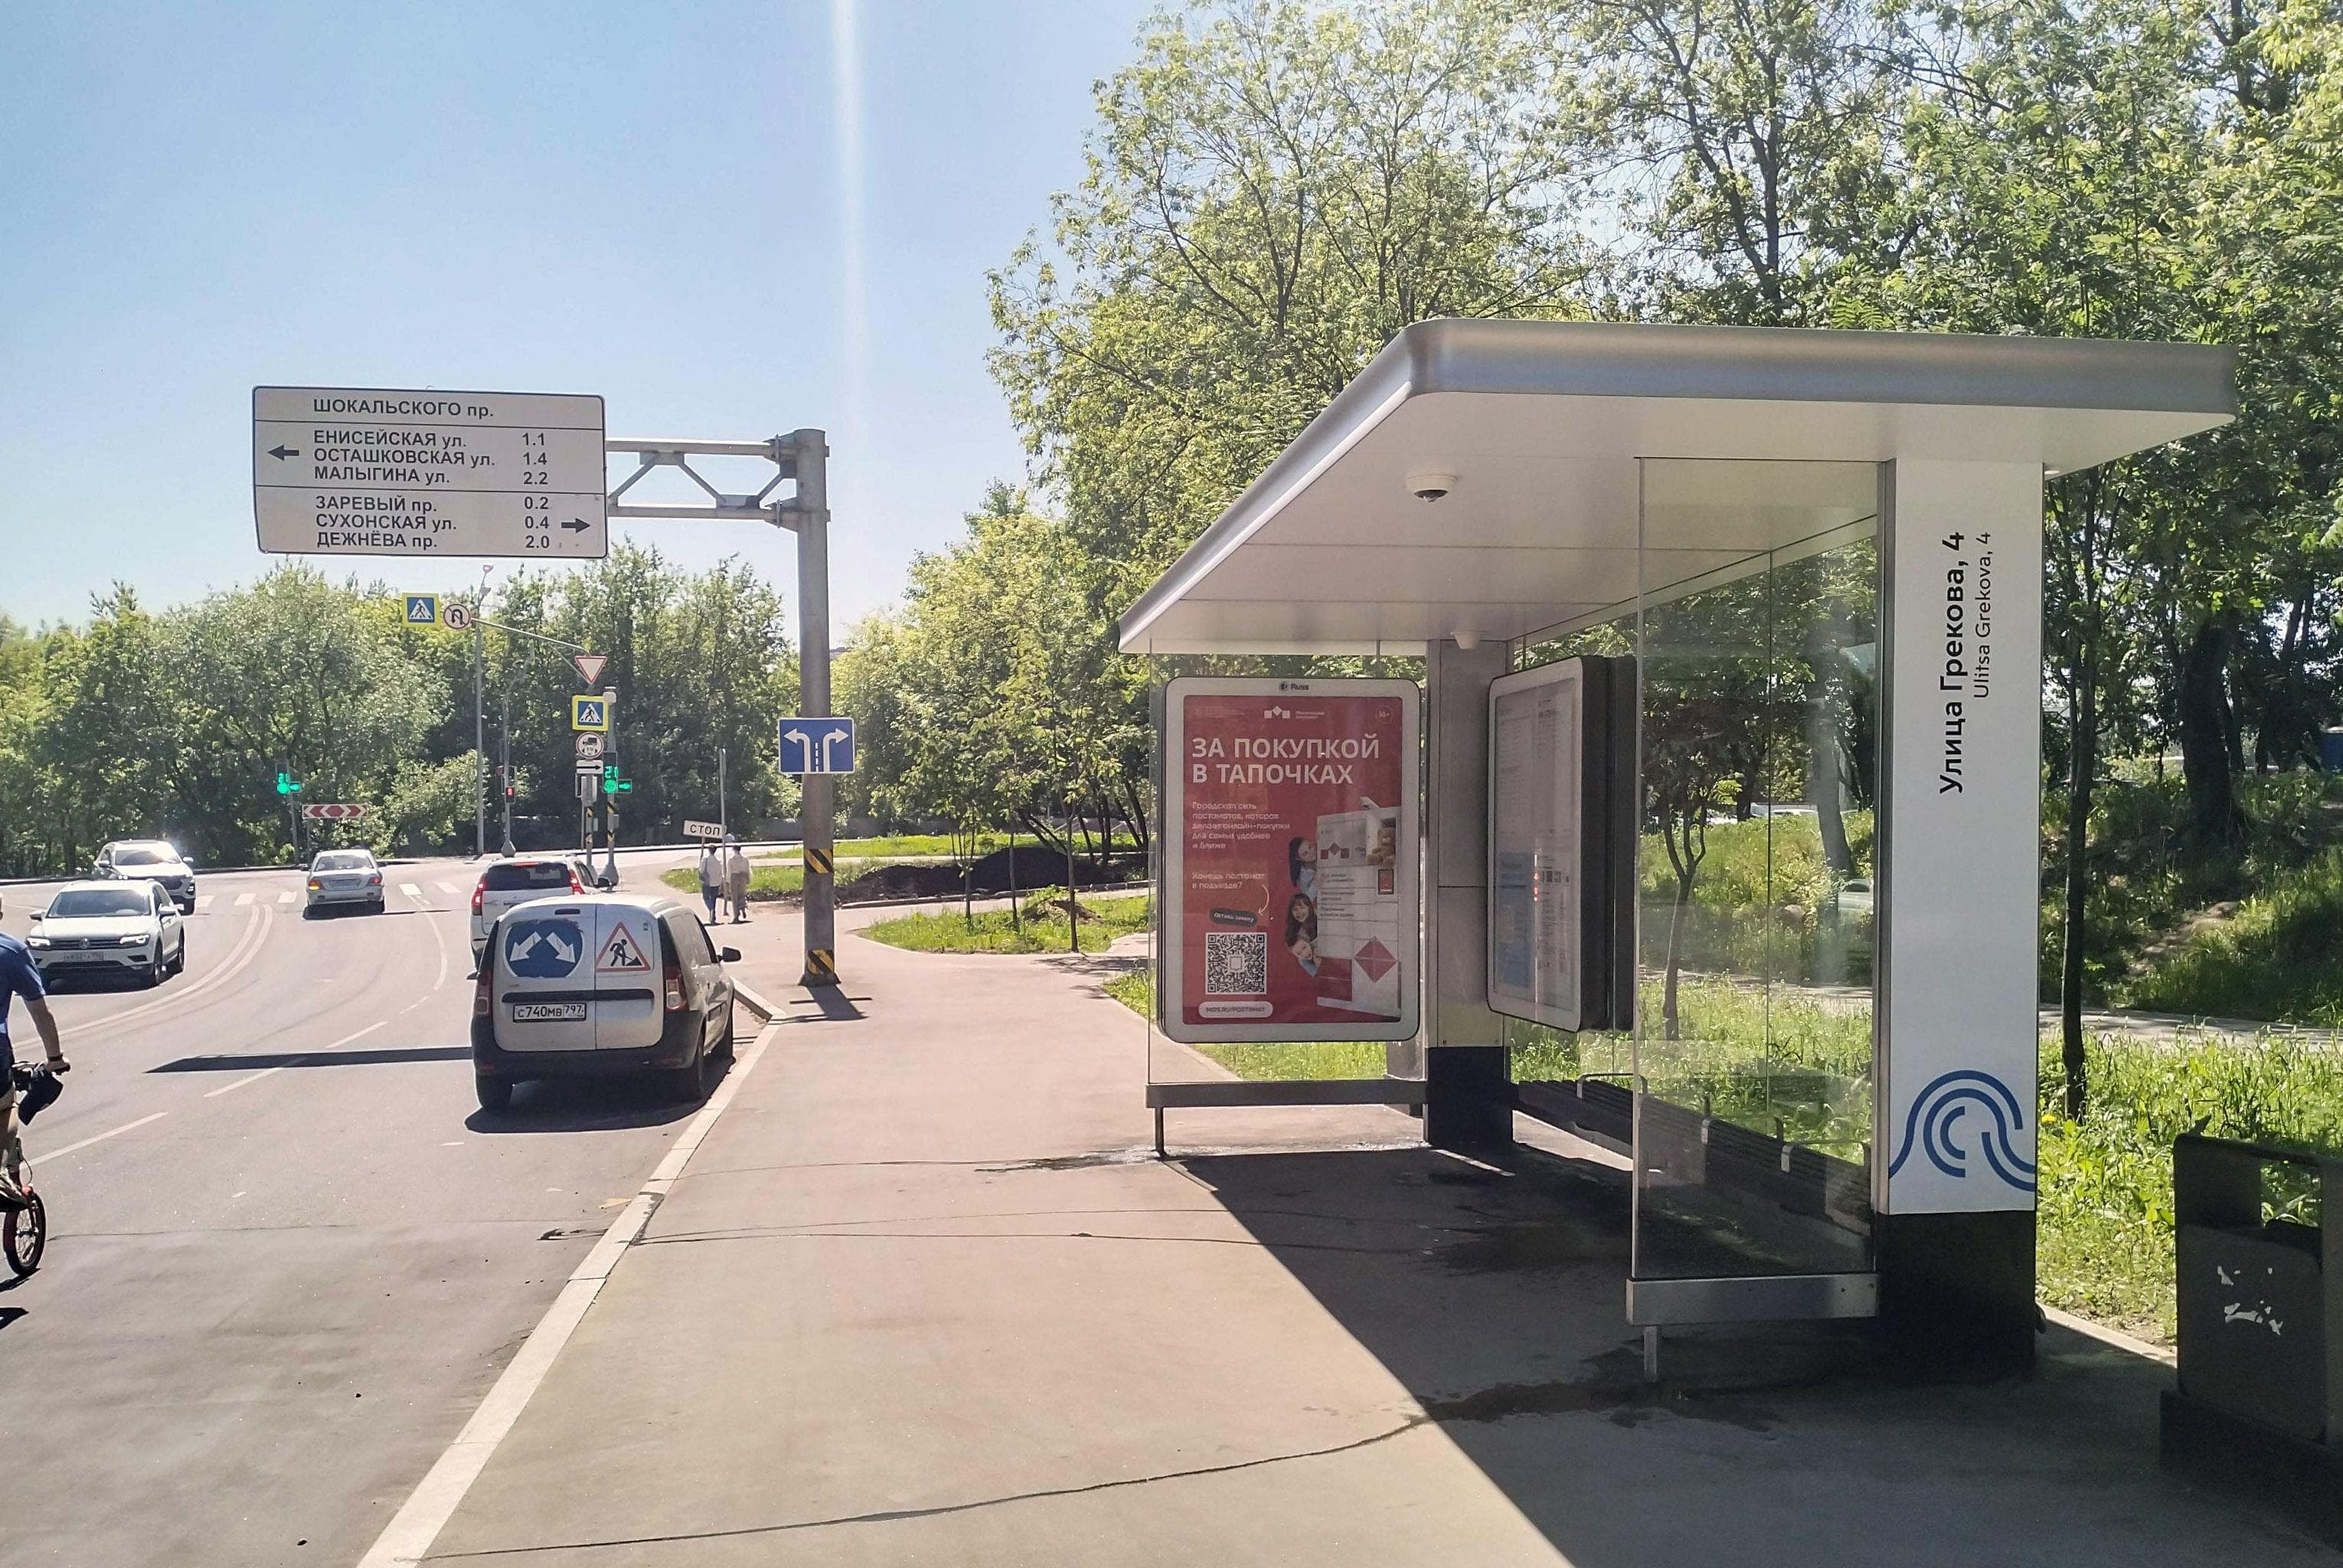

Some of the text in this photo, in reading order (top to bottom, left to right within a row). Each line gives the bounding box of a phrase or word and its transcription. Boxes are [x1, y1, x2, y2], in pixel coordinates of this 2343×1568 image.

[313, 398, 494, 420] ШОКАЛЬСКОГО пр.
[314, 428, 544, 450] ЕНИСЕЙСКАЯ ул. 1.1
[314, 448, 547, 469] ОСТАШКОВСКАЯ ул. 1.4
[314, 466, 548, 487] МАЛЫГИНА ул. 2.2
[315, 495, 549, 515] ЗАРЕВЫЙ пр. 0.2
[315, 514, 550, 534] СУХОНСКАЯ ул. 0.4
[316, 530, 550, 551] ДЕЖНЁВА пр. 2.0
[1973, 531, 1994, 699] Ulitsa Grekova, 4
[1939, 531, 1969, 794] Улица Грекова, 4
[1191, 733, 1380, 760] ЗА ПОКУПКОЙ
[1192, 763, 1354, 785] В ТАПОЧКАХ
[690, 824, 721, 835] СТОП
